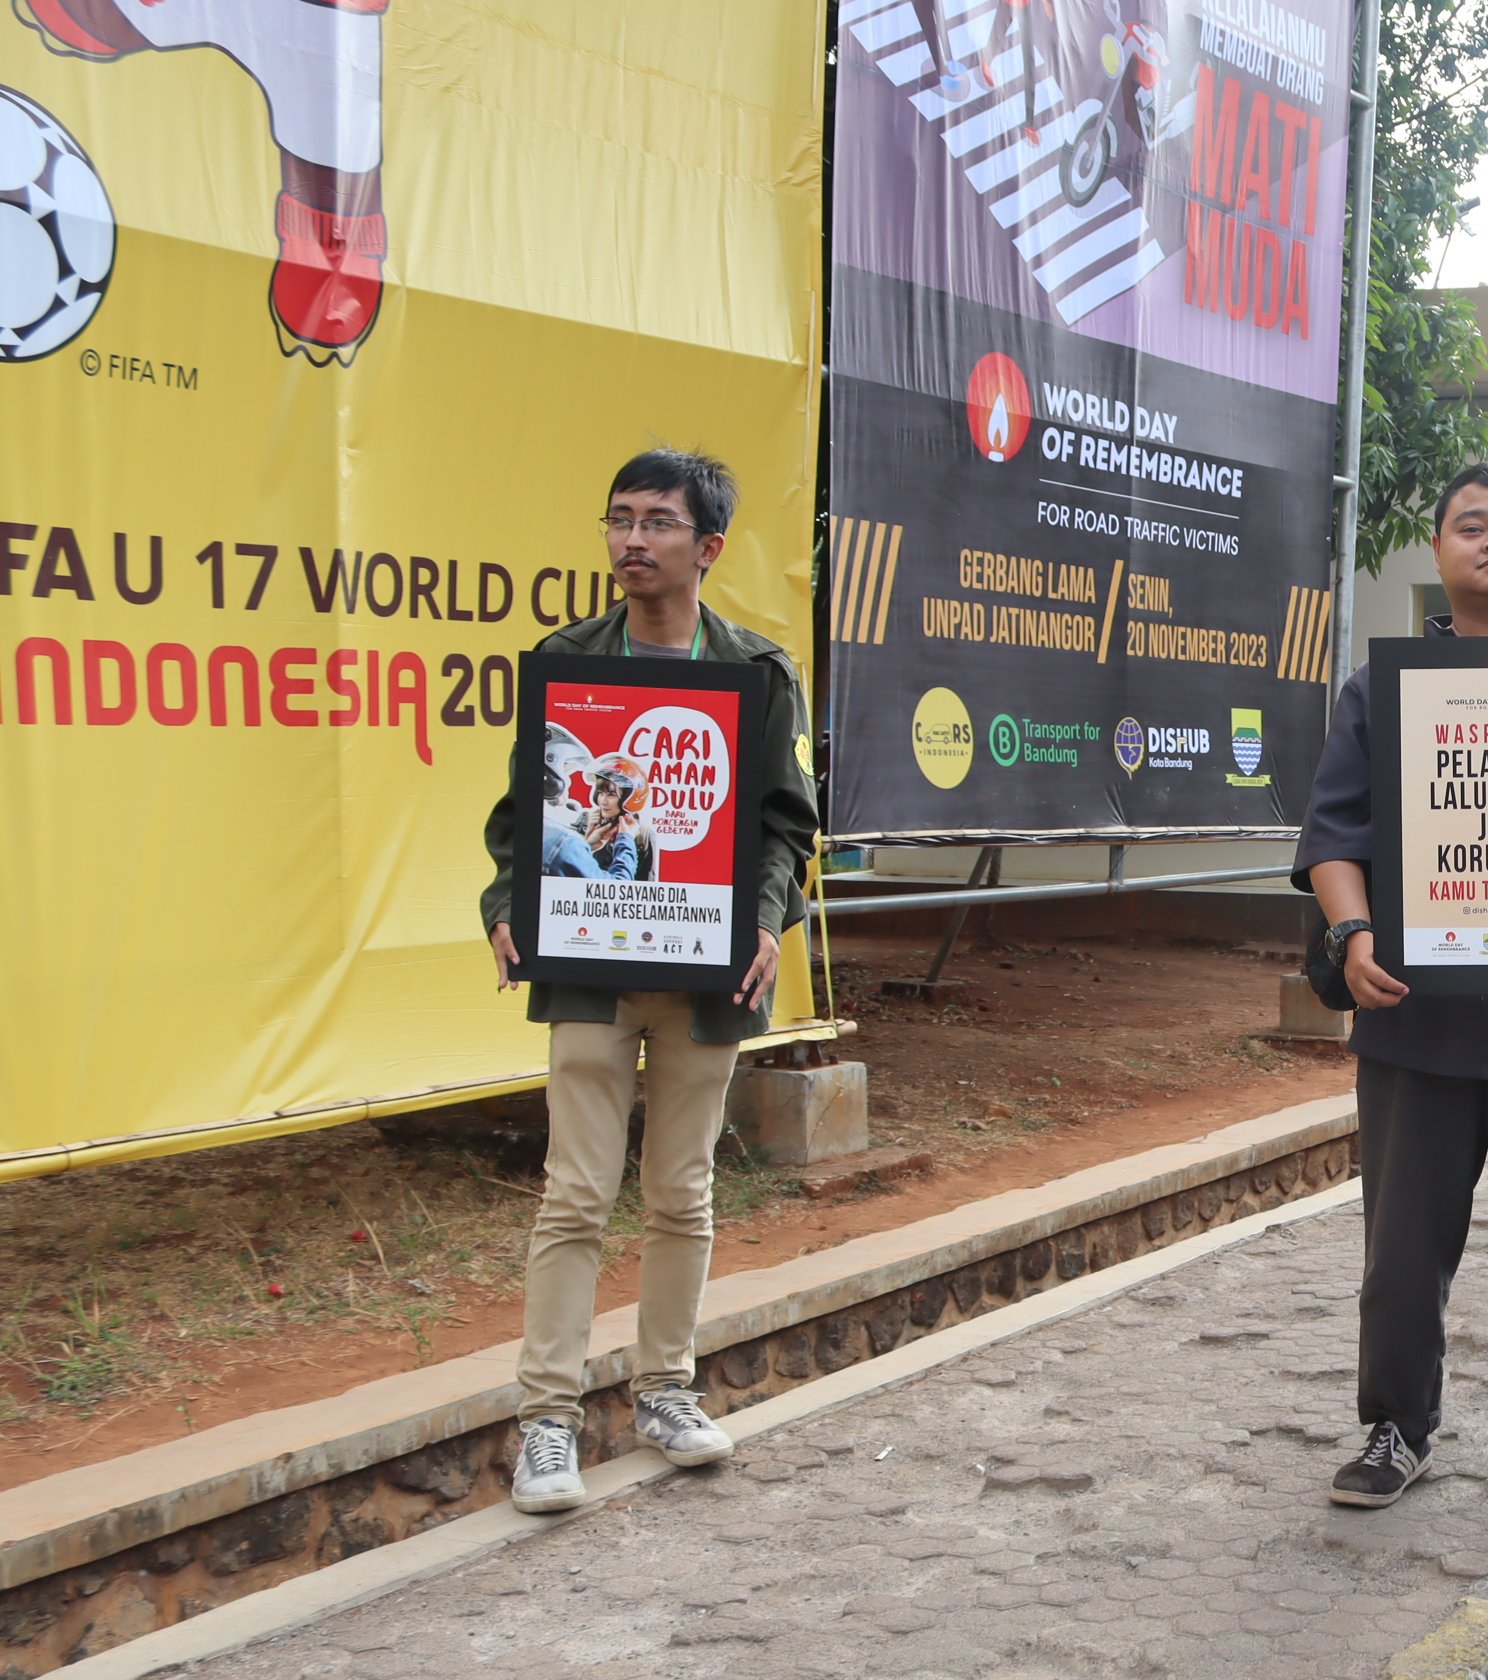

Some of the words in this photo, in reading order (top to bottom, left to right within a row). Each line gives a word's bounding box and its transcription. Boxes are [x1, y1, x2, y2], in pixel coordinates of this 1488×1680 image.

[1201, 0, 1326, 68] LALAIANMU
[1200, 14, 1276, 82] MEMBUAT
[1276, 53, 1325, 106] ORANG
[1191, 63, 1322, 236] MATI
[1184, 200, 1310, 341] MUDA
[108, 353, 157, 385] FIFA
[161, 362, 199, 391] TM
[1043, 381, 1130, 433] WORLD
[1136, 406, 1178, 444] DAY
[1041, 426, 1076, 463] OF
[1079, 434, 1244, 498] REMEMBRANCE
[1037, 501, 1069, 528] FOR
[1074, 508, 1120, 536] ROAD
[1124, 516, 1180, 546] TRAFFIC
[1183, 527, 1239, 556] VICTIMS
[114, 532, 163, 605] U
[195, 541, 279, 611] 17
[298, 546, 514, 623] WORLD
[959, 548, 1044, 597] GERBANG
[1047, 561, 1097, 604] LAMA
[1127, 572, 1173, 619] SENIN,
[922, 597, 985, 642] UNPAD
[989, 604, 1096, 653] JATINANGOR
[1126, 620, 1145, 657] 20
[1148, 623, 1227, 664] NOVEMBER
[1229, 632, 1267, 668] 2023
[0, 636, 433, 766] NDONESIA
[628, 726, 711, 761] CARI
[1022, 718, 1080, 742] Transport
[1084, 722, 1101, 741] for
[1148, 726, 1210, 754] DISHUB
[648, 760, 716, 787] AMAN
[1024, 743, 1078, 768] Bandung
[1149, 757, 1165, 768] Kota
[1165, 757, 1193, 771] Bandung
[651, 786, 715, 811] DULU
[665, 810, 686, 819] BARU
[652, 817, 698, 827] BONCENGIN
[656, 826, 694, 835] GEBETAN
[586, 883, 616, 900] KALO
[618, 884, 665, 903] SAYANG
[668, 887, 688, 904] DIA
[1429, 880, 1476, 901] KAMU
[550, 900, 579, 917] JAGA
[581, 901, 610, 918] JUGA
[613, 903, 722, 924] KESELAMATANNYA
